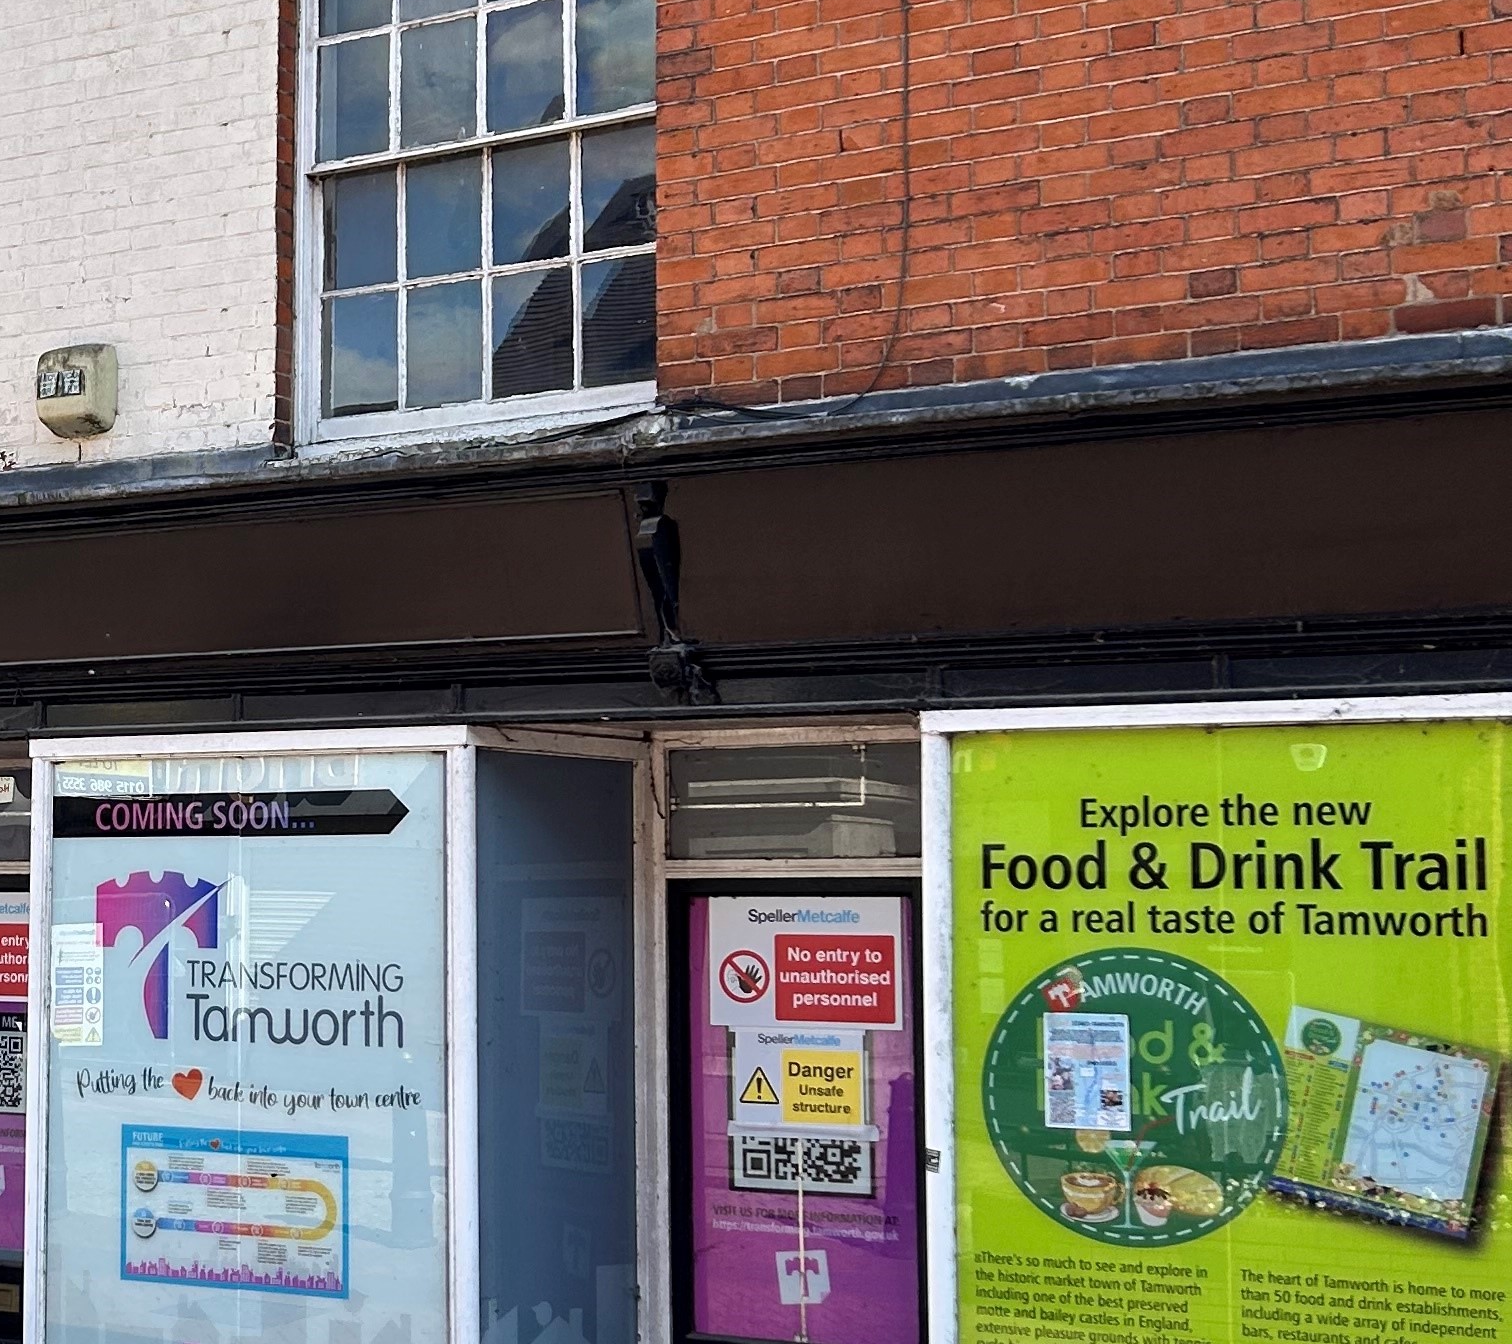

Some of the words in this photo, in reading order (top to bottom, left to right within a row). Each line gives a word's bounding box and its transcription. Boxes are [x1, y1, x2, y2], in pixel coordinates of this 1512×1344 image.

[96, 801, 203, 831] COMING
[213, 800, 315, 830] SOON...
[1080, 795, 1209, 835] Explore
[1221, 793, 1279, 826] the
[1293, 801, 1371, 826] new
[982, 839, 1107, 891] Food
[1129, 841, 1169, 890] &
[1191, 838, 1342, 891] Drink
[1360, 838, 1487, 891] Trail
[748, 909, 860, 924] SpellerMetcalfe
[981, 901, 1028, 933] for
[1039, 911, 1058, 932] a
[1072, 901, 1135, 933] real
[1148, 906, 1235, 934] taste
[1248, 901, 1286, 934] of
[1297, 903, 1488, 937] Tamworth
[788, 947, 810, 962] No
[816, 948, 860, 966] entry
[865, 949, 882, 962] to
[187, 959, 404, 992] TRANSFORMING
[780, 970, 890, 985] unauthorised
[793, 992, 877, 1008] personnel
[2, 1017, 17, 1028] ME
[186, 994, 404, 1048] Tamworth
[788, 1062, 853, 1081] Danger
[76, 1067, 137, 1098] Putting
[142, 1067, 164, 1090] the
[208, 1076, 244, 1102] back
[249, 1084, 277, 1109] into
[284, 1093, 324, 1115] your
[330, 1088, 369, 1110] town
[376, 1085, 422, 1107] centre
[799, 1084, 843, 1097] Unsafe
[1160, 1066, 1260, 1134] Trail
[792, 1102, 851, 1114] structure
[713, 1206, 737, 1215] VISIT
[740, 1207, 752, 1217] US
[809, 1211, 882, 1225] INFORMATION
[1241, 1269, 1264, 1283] The
[1268, 1272, 1301, 1286] heart
[1306, 1274, 1319, 1287] of
[1323, 1276, 1388, 1293] Tamworth
[1394, 1281, 1404, 1293] is
[1408, 1282, 1447, 1297] home
[1451, 1285, 1464, 1298] to
[1470, 1288, 1505, 1302] more
[1241, 1288, 1270, 1302] than
[1274, 1290, 1290, 1303] 50
[1295, 1292, 1325, 1305] food
[1329, 1295, 1354, 1308] and
[1358, 1298, 1392, 1311] drink
[1397, 1300, 1504, 1322] establishments,
[1241, 1307, 1301, 1325] including
[1305, 1314, 1313, 1324] a
[1317, 1312, 1349, 1327] wide
[1353, 1316, 1387, 1331] array
[1392, 1318, 1407, 1330] of
[1409, 1319, 1496, 1339] independent
[1242, 1324, 1273, 1340] bars,
